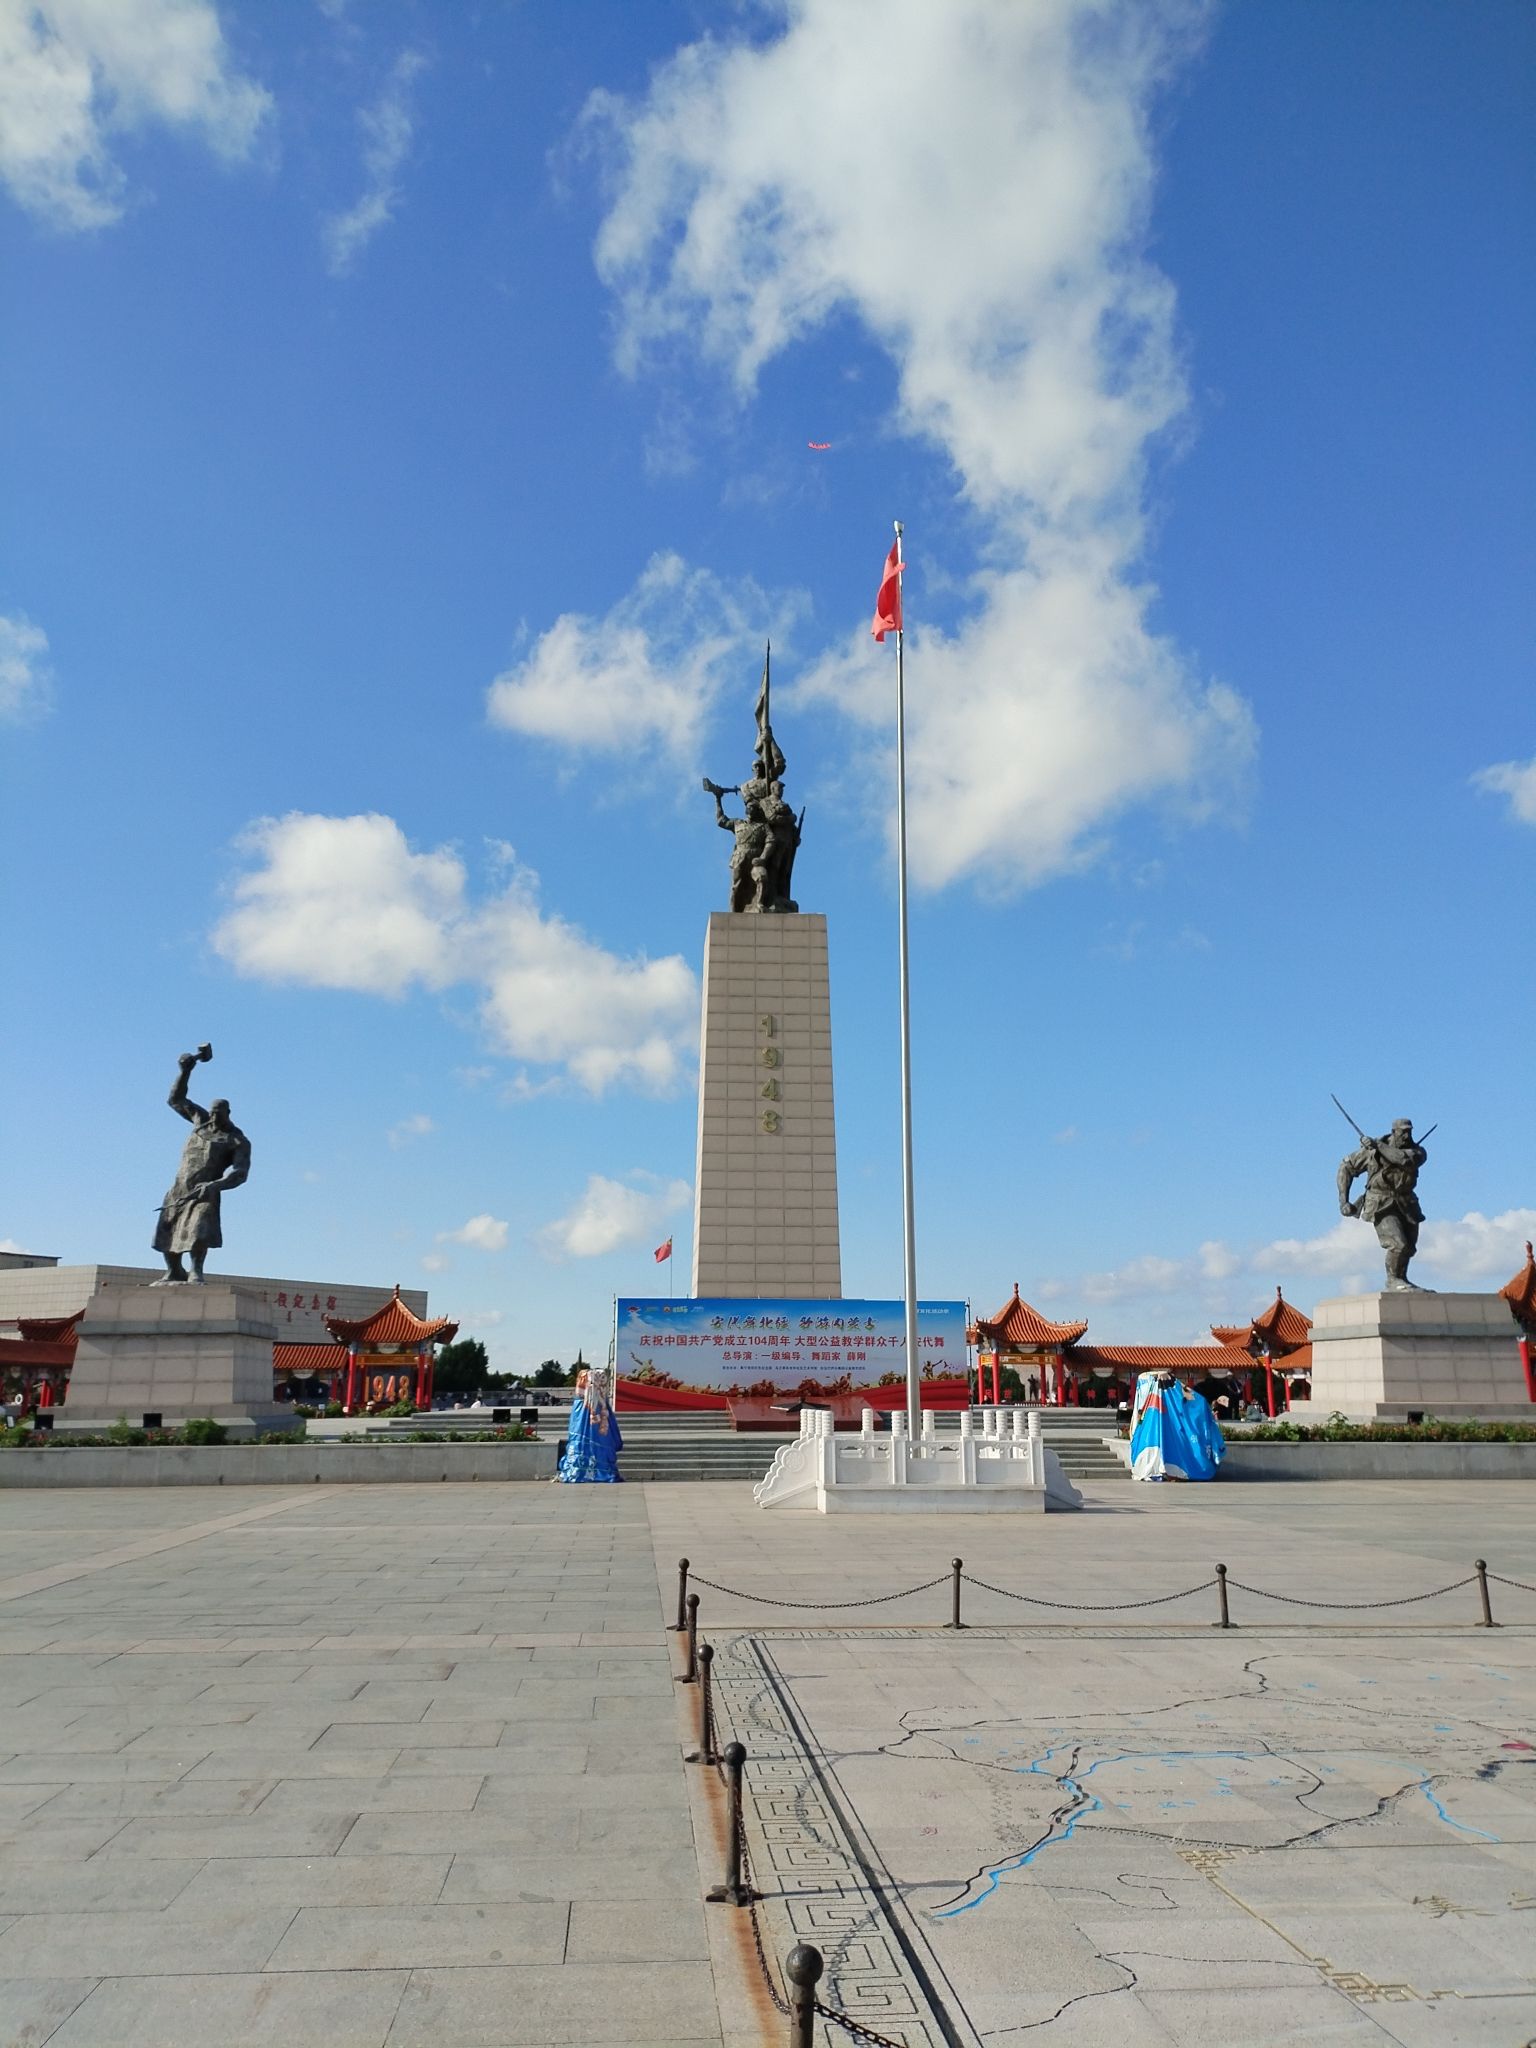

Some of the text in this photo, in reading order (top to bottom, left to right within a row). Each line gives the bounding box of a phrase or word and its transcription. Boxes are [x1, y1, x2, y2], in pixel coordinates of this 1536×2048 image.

[761, 1015, 779, 1133] 1948
[639, 1335, 791, 1347] 庆祝中国共产党成立104周年
[364, 1375, 410, 1402] 1948
